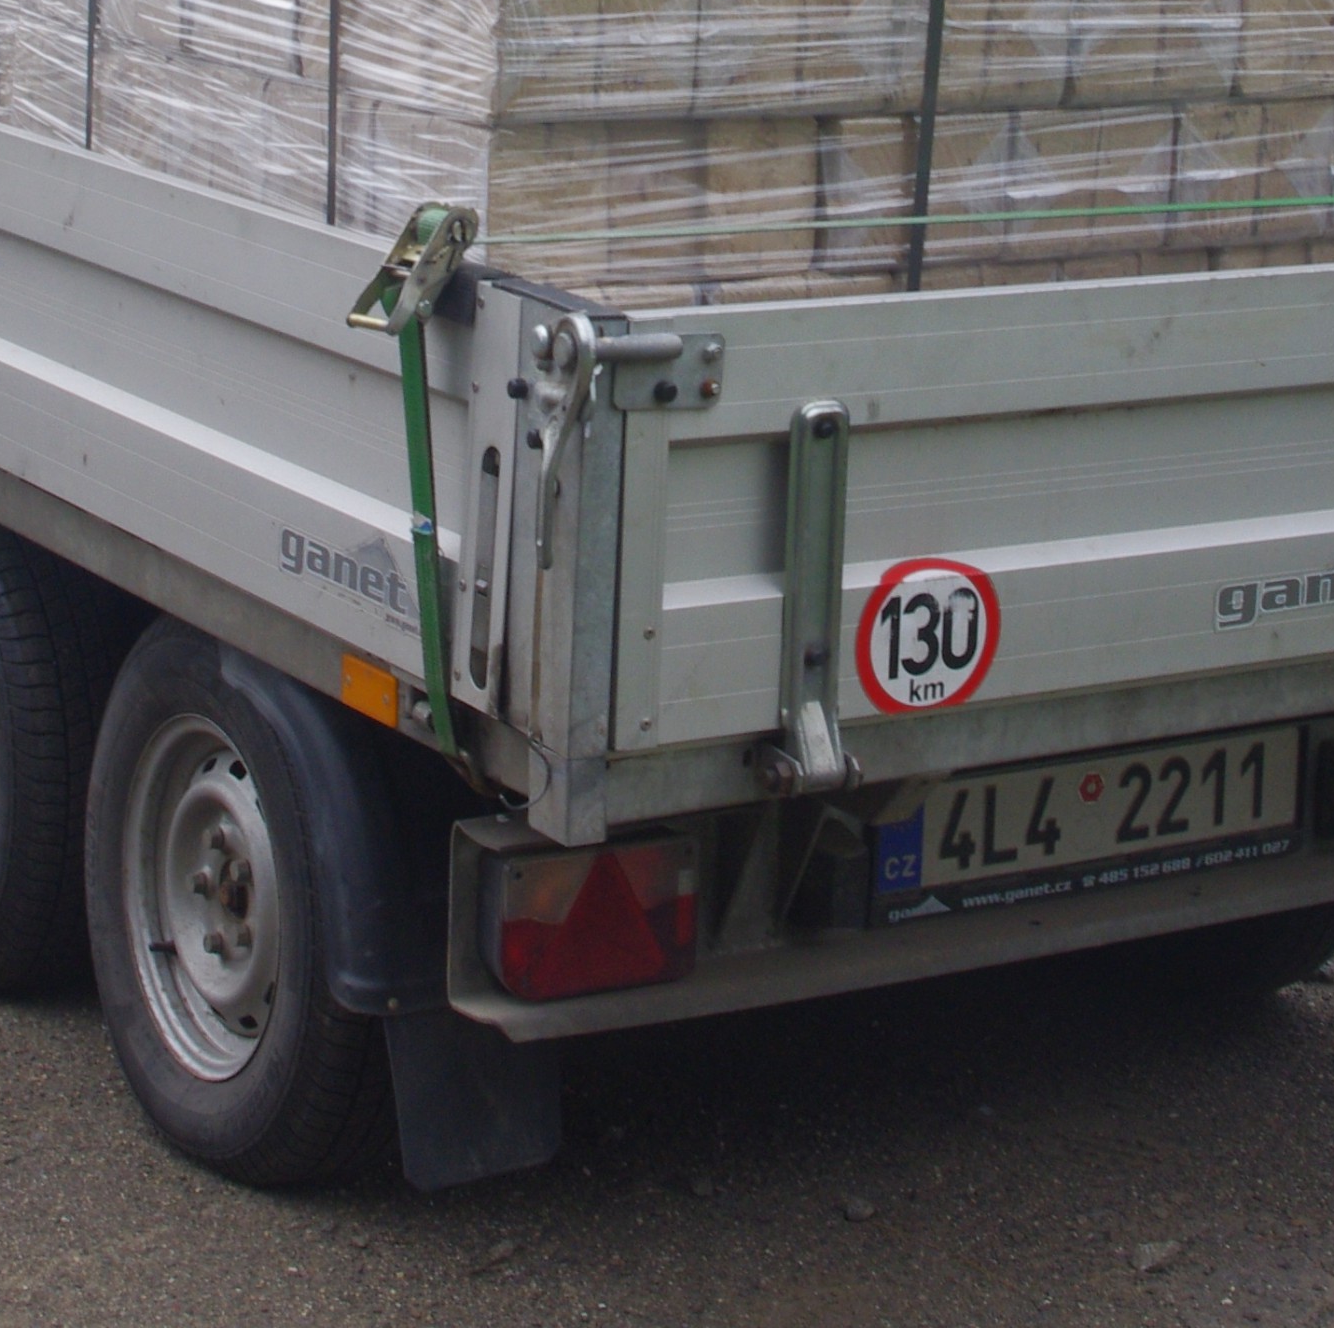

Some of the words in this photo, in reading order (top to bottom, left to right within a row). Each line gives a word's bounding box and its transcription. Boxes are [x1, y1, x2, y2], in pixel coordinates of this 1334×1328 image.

[281, 528, 407, 615] ganet
[880, 586, 980, 681] 130
[908, 678, 946, 703] km
[938, 775, 1062, 870] 4L4
[1115, 740, 1266, 845] 2211
[884, 855, 918, 880] CZ
[961, 879, 1073, 908] www.ganet.cz
[1099, 868, 1129, 885] 485
[1133, 863, 1160, 880] 152
[1234, 846, 1259, 860] 411
